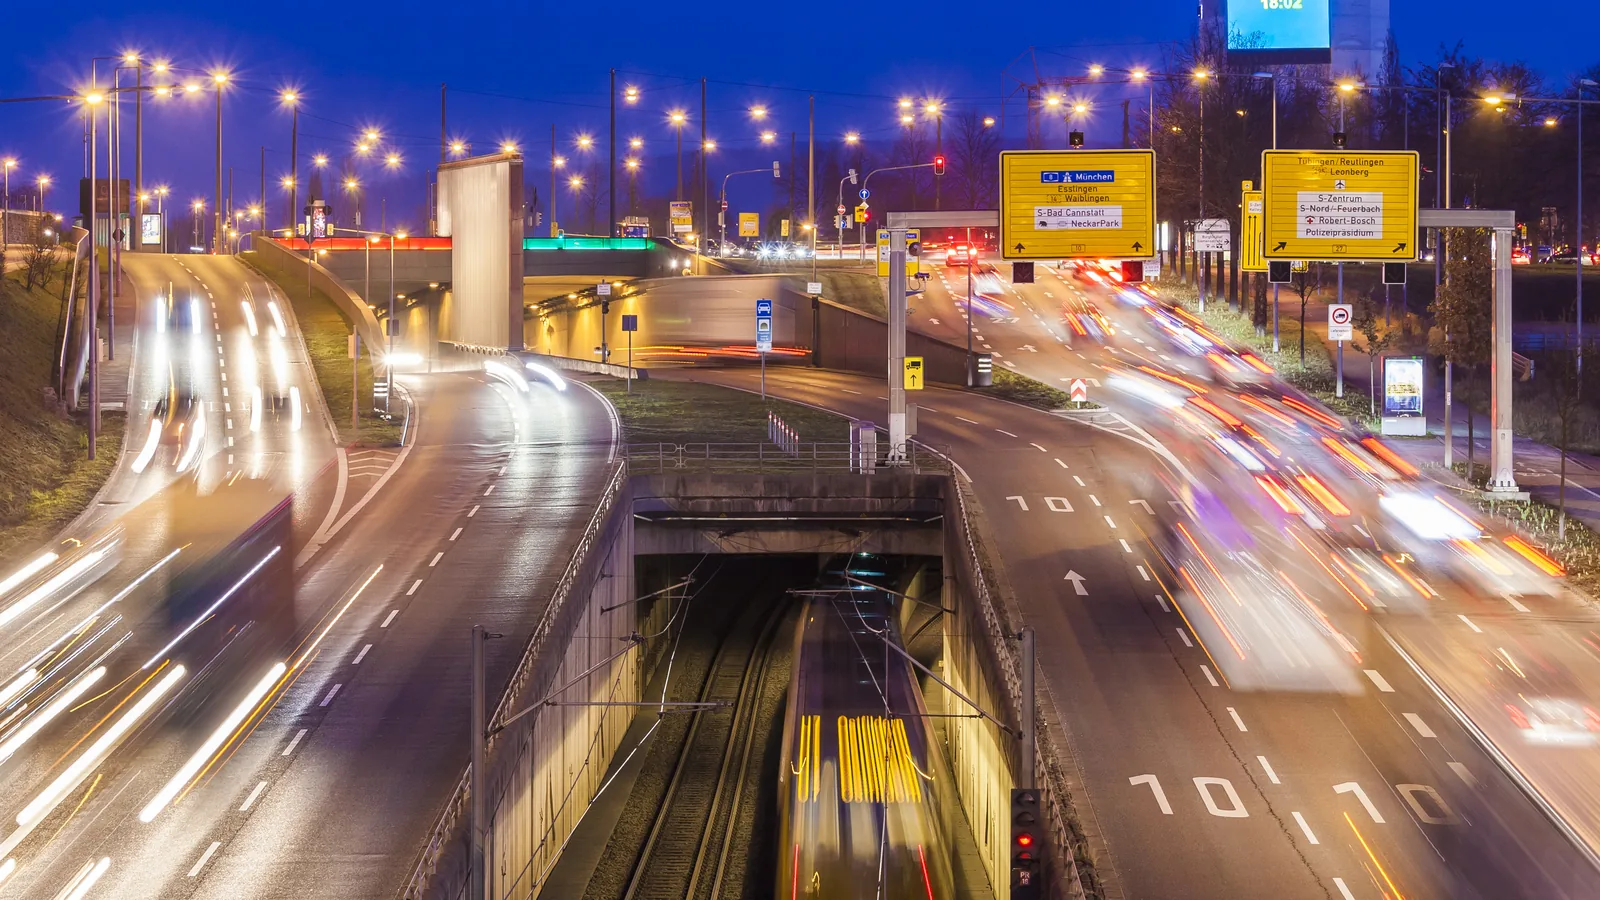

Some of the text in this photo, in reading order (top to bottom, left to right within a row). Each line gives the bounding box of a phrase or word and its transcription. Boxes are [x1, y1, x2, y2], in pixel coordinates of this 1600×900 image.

[1260, 0, 1303, 9] 18:02
[1075, 172, 1113, 181] München
[1330, 168, 1369, 177] Leonberg
[1057, 185, 1098, 194] Esslingen
[1065, 194, 1110, 203] Waiblingen
[1318, 194, 1363, 203] S-Zentrum
[1037, 208, 1105, 217] S-Bad Cannstatt
[1300, 204, 1381, 213] S-Nord/-Feuerbach
[1071, 220, 1119, 228] NeckarPark
[1319, 216, 1376, 225] Robert-Bosch
[1305, 228, 1374, 238] Polizeipräsidium
[1005, 495, 1075, 513] 10
[1128, 773, 1250, 818] 10
[1332, 781, 1462, 825] 10
